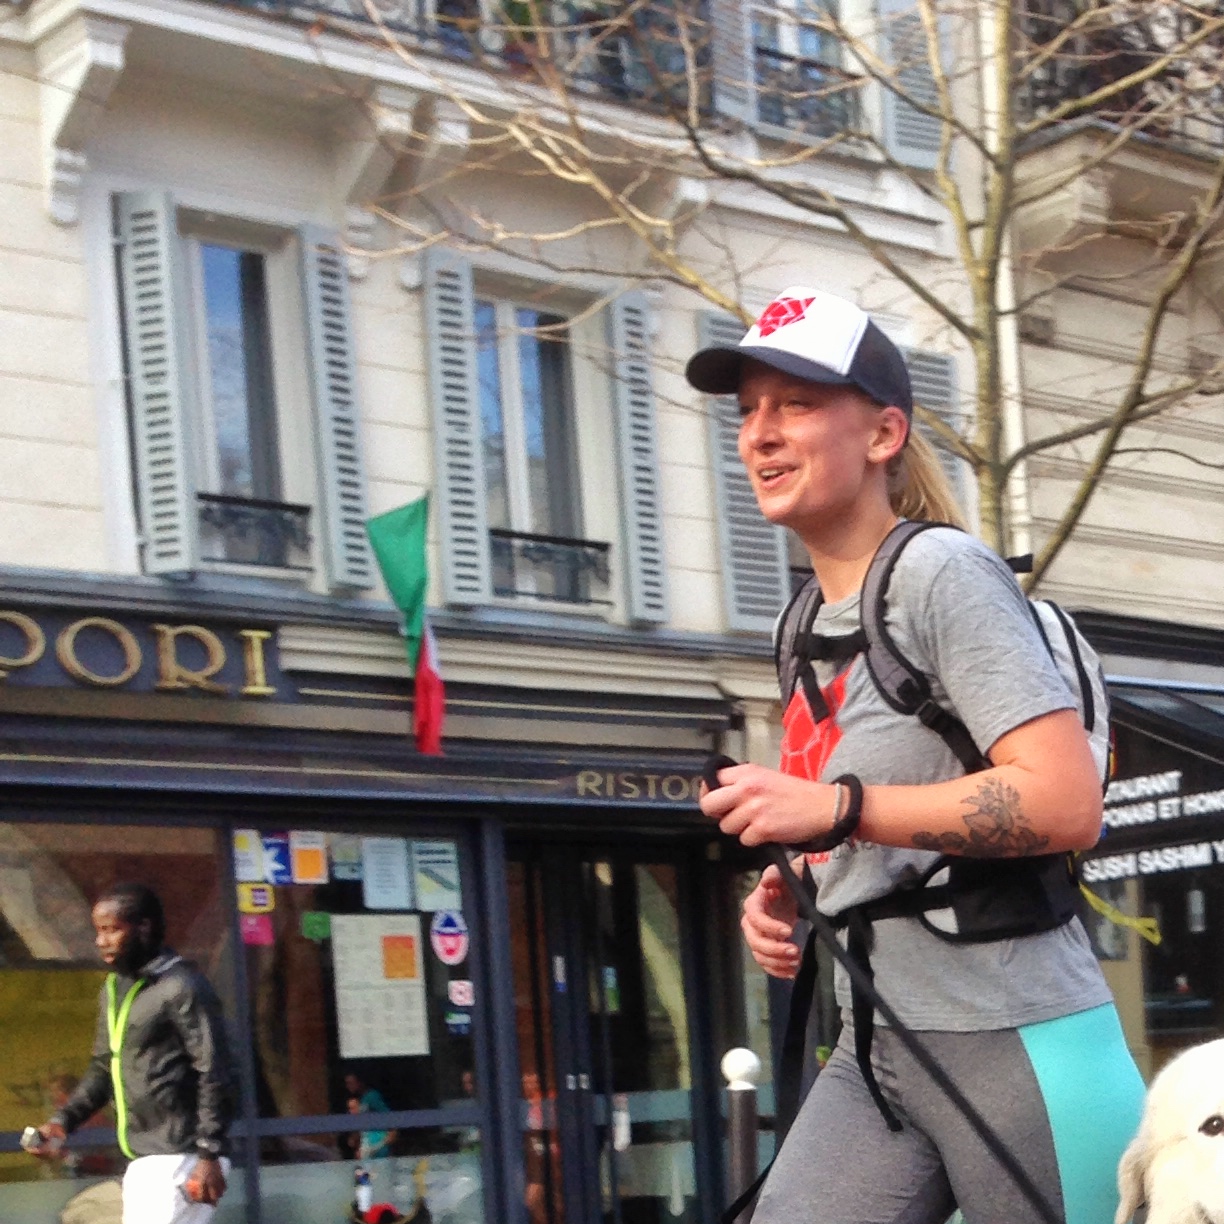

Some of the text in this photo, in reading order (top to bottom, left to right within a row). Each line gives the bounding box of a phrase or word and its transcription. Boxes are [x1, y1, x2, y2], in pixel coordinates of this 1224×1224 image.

[1157, 796, 1181, 820] ET
[1082, 852, 1138, 883] SUSHI
[1138, 841, 1214, 875] SASHIMI
